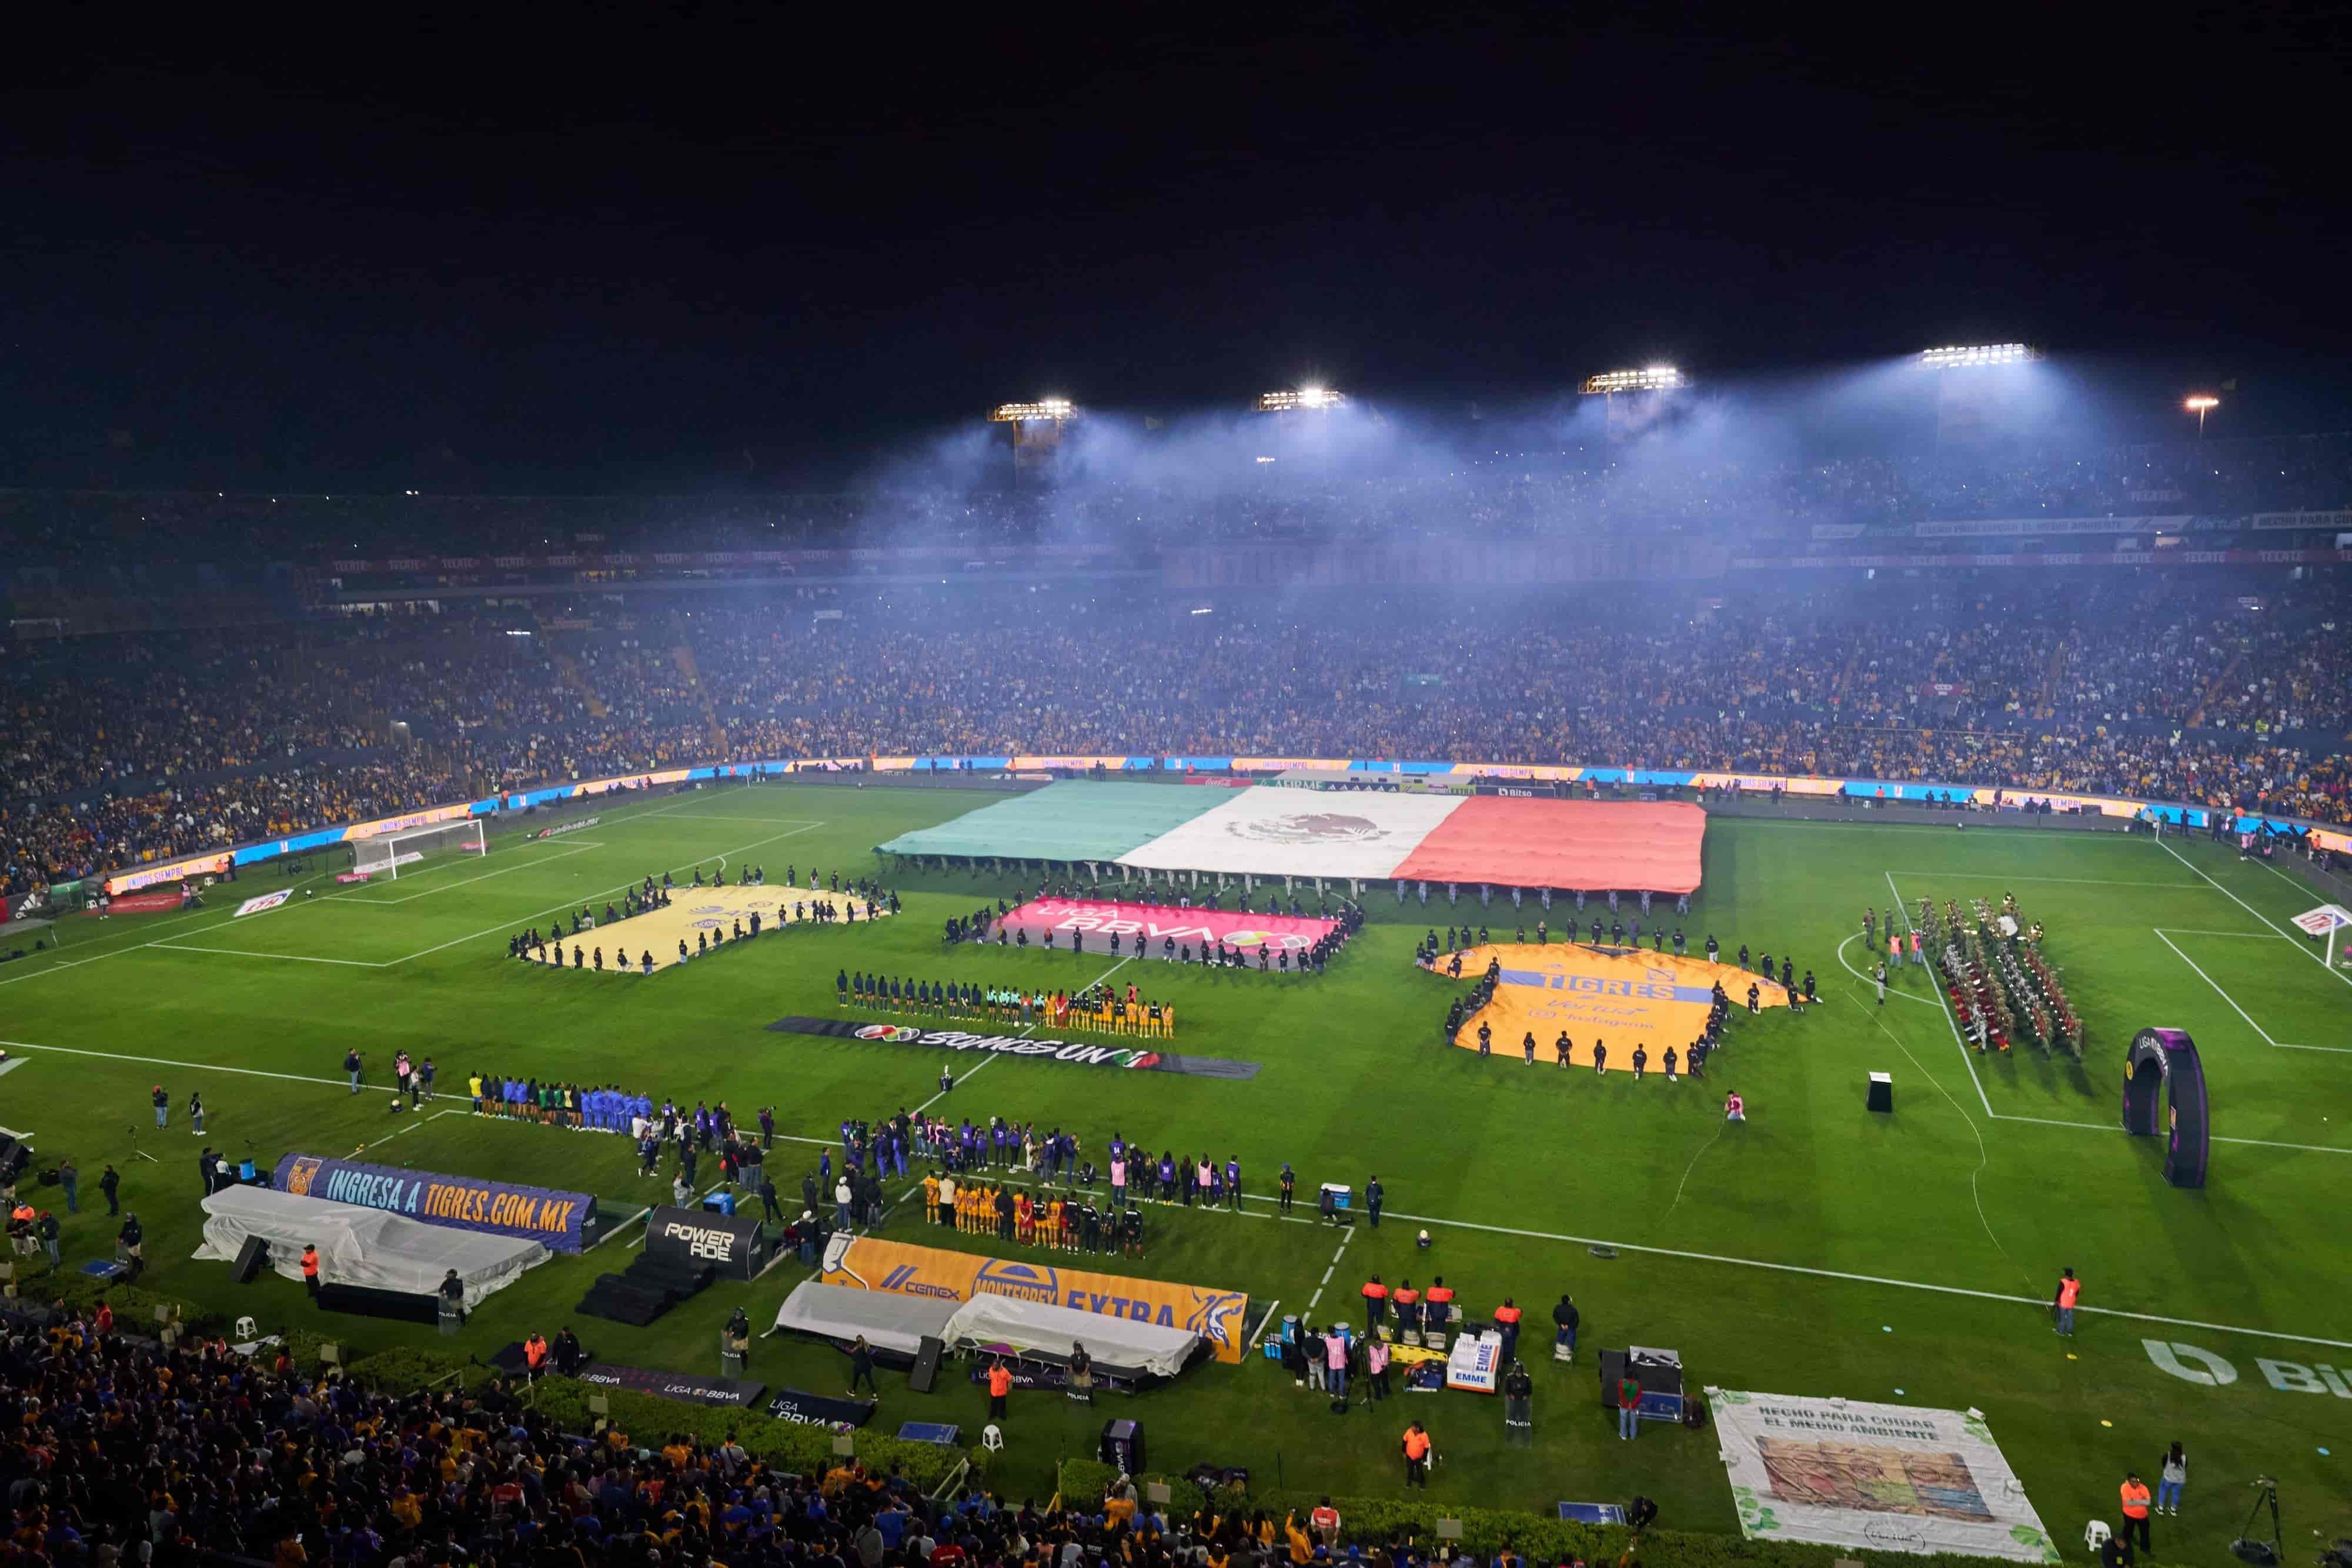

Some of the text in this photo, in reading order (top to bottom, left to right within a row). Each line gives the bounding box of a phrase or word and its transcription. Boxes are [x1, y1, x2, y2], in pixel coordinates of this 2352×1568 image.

[1510, 788, 1532, 797] Bitso
[126, 866, 183, 888] UNIDOS SIEMPRE
[1036, 906, 1118, 919] LIGA
[1055, 917, 1214, 942] BBVA
[1539, 973, 1675, 1001] TIGRES
[917, 1031, 1064, 1054] SOMOS
[2139, 1035, 2150, 1049] LIGA
[327, 1168, 575, 1233] INGRESA A TIGRES.COM.MX
[664, 1222, 735, 1248] POWER
[904, 1281, 960, 1301] CEMEX
[1066, 1289, 1175, 1331] EXTRA
[1475, 1343, 1494, 1373] EMME
[588, 1373, 620, 1385] BBVA
[1455, 1372, 1488, 1383] EMME
[664, 1383, 740, 1401] LIGA BBVA
[1067, 1392, 1090, 1401] POLICIA
[769, 1398, 799, 1412] LIGA
[1505, 1419, 1532, 1427] POLICIA
[1758, 1405, 1936, 1429] HECHO PARA CUIDAR
[1763, 1416, 1940, 1440] EL MEDIO AMBIENTE
